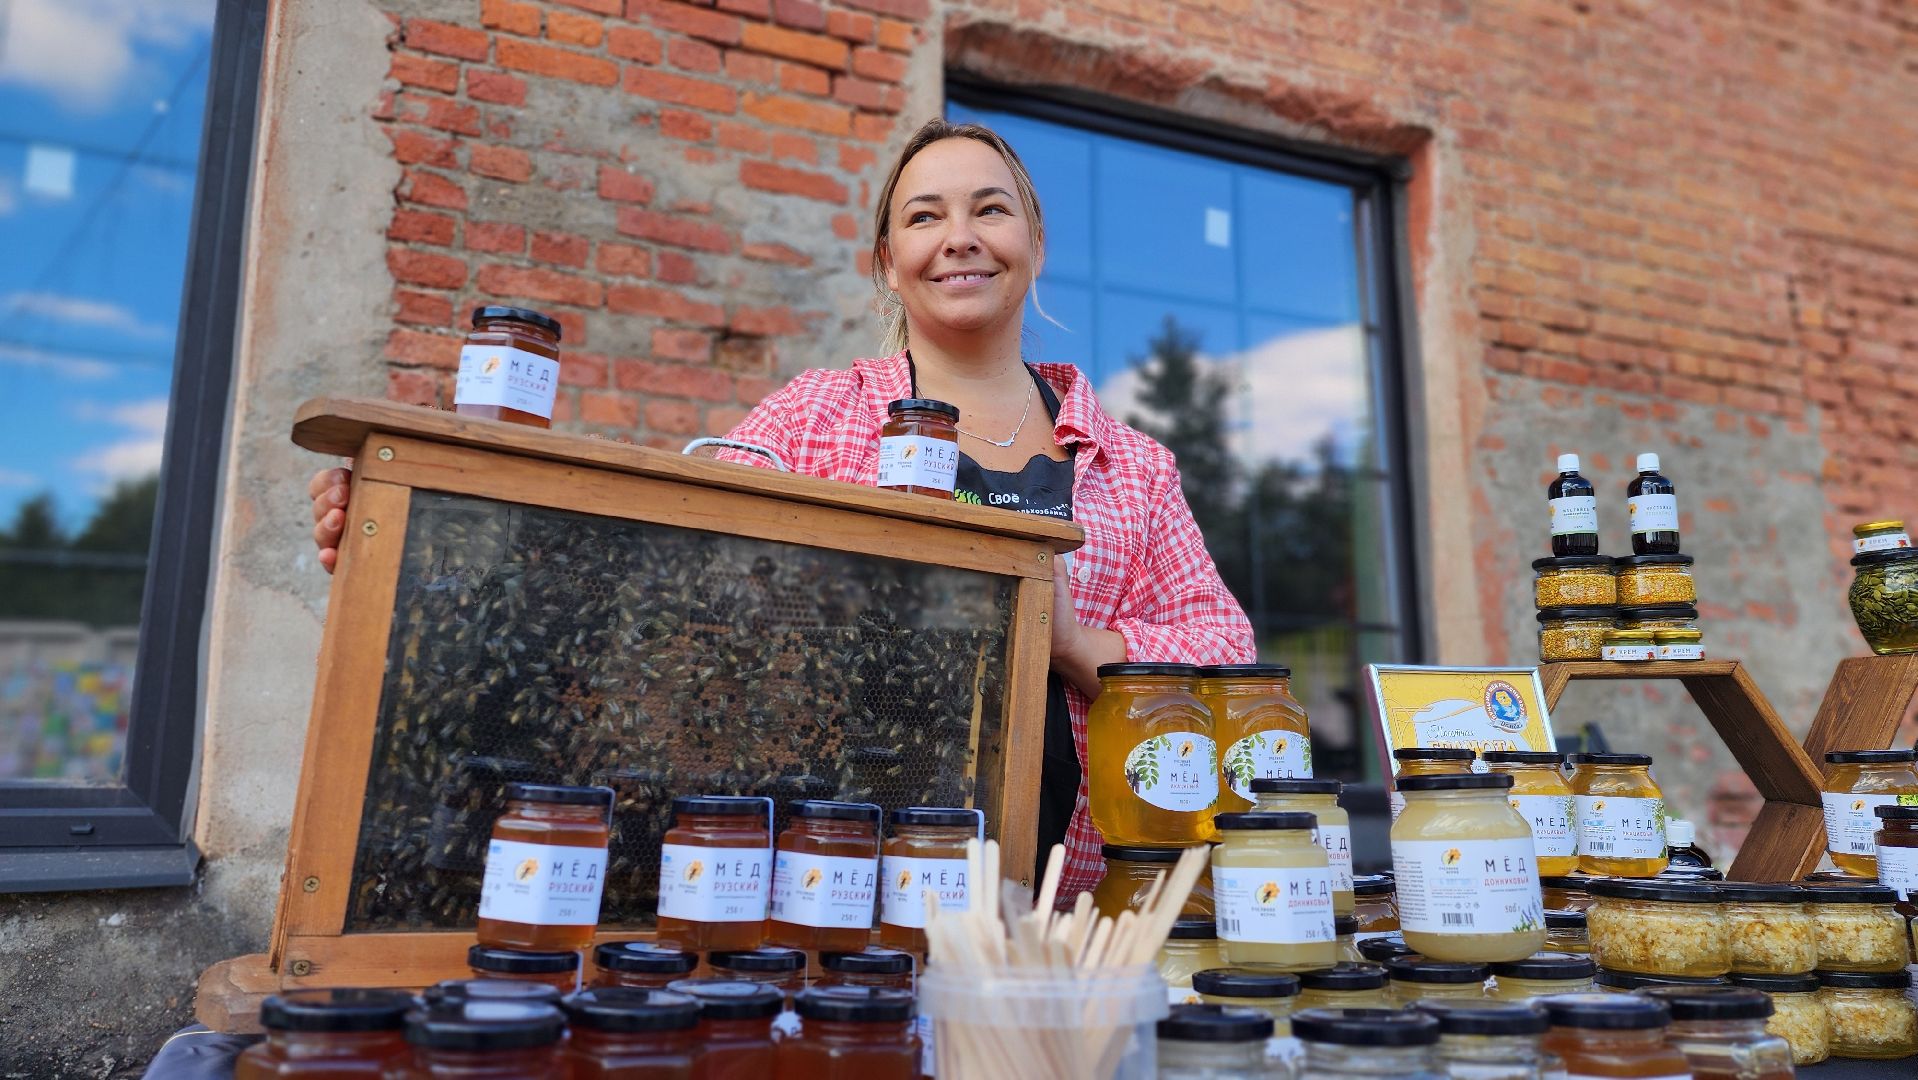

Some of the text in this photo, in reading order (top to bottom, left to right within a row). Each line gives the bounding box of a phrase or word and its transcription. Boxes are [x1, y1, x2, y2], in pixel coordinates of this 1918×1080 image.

[510, 359, 550, 382] МЁД
[508, 375, 548, 391] РУЗСКИЙ
[925, 446, 956, 461] МЁД
[924, 459, 955, 470] РУЗСКИЙ
[988, 492, 1020, 505] Своё
[1017, 508, 1068, 517] льхозбанка
[1170, 770, 1199, 783] МЁД
[1266, 767, 1293, 779] МЁД
[1535, 816, 1566, 827] МЁД
[1621, 817, 1653, 830] МЁД
[551, 859, 598, 880] МЁД
[715, 859, 761, 879] МЁД
[1484, 855, 1527, 874] МЁД
[833, 869, 874, 887] МЁД
[921, 869, 966, 887] МЁД
[1484, 876, 1529, 887] ДОННИКОВЫЙ
[548, 881, 595, 893] РУЗСКИЙ
[713, 881, 759, 892] РУЗСКИЙ
[1290, 878, 1328, 897] МЁД
[831, 890, 872, 900] РУЗСКИЙ
[921, 889, 965, 900] РСКИЙ
[1288, 898, 1330, 908] ДОННИКОВЫЙ
